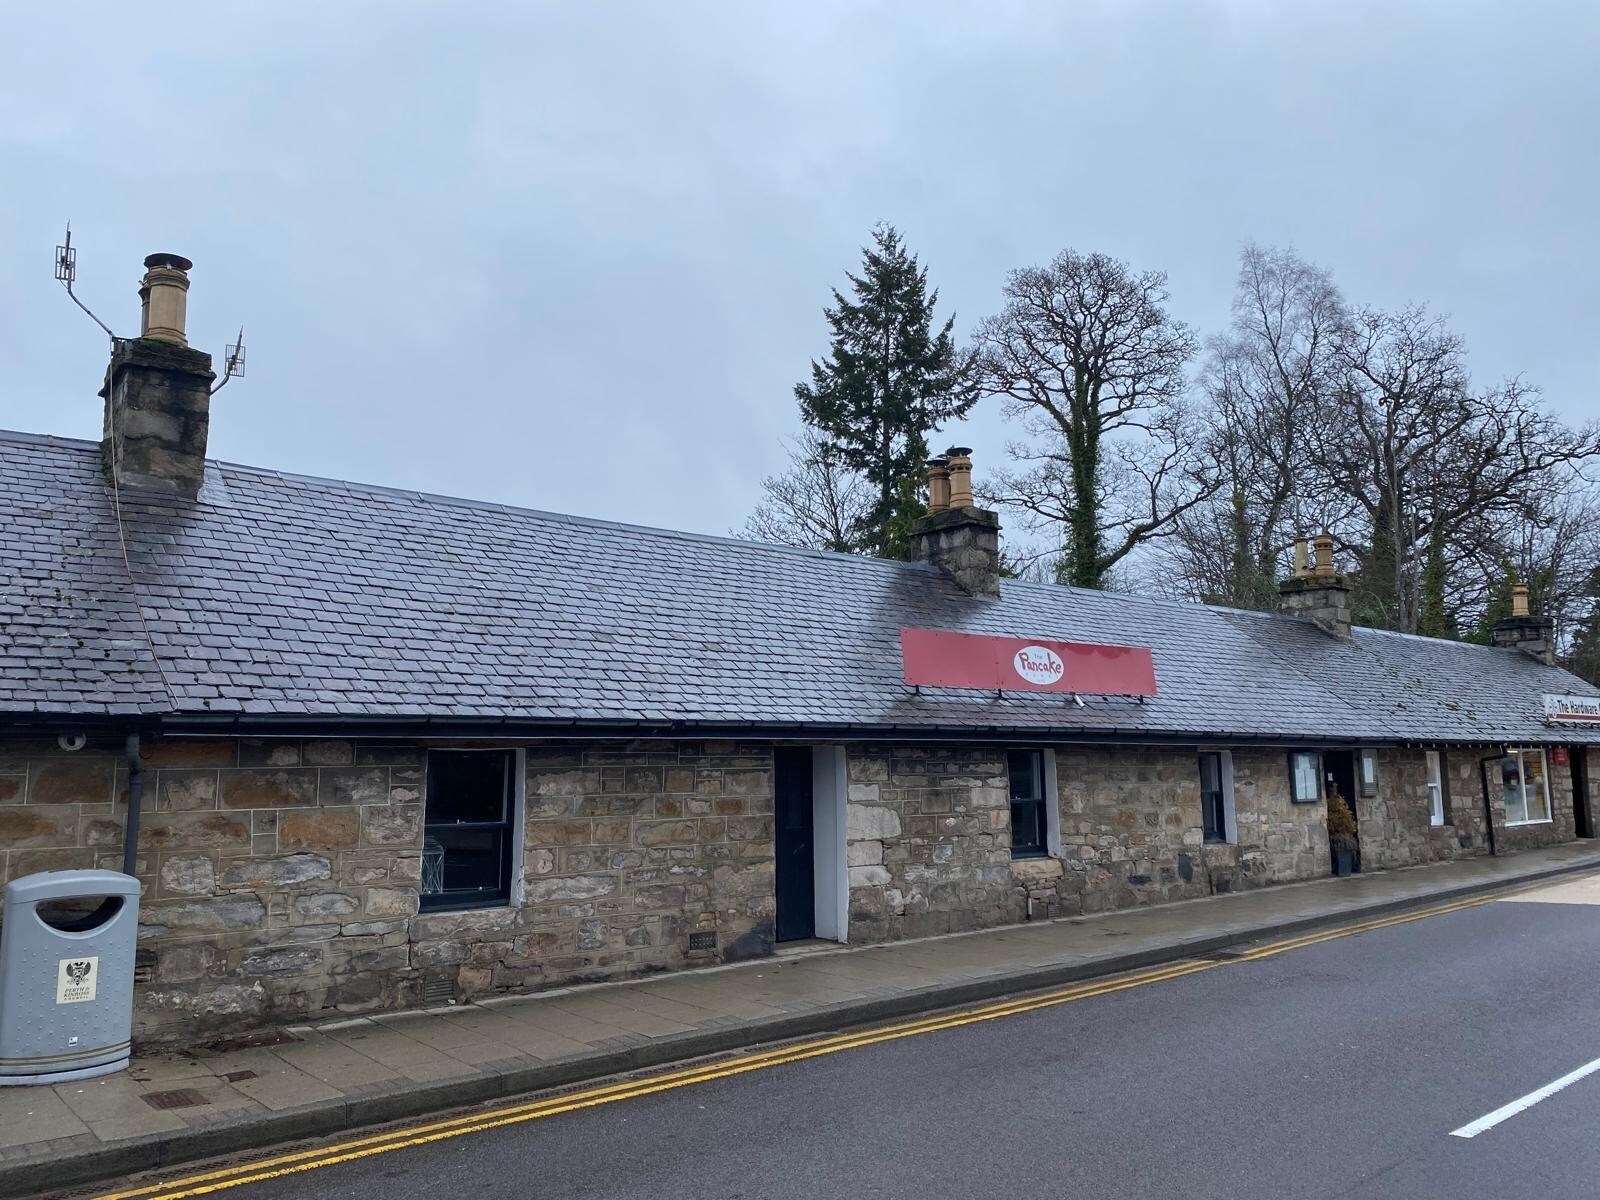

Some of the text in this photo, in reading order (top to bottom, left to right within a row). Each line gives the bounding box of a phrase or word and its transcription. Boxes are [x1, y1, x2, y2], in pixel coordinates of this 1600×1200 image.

[1018, 652, 1062, 674] Pancake
[1557, 699, 1570, 714] The
[1569, 700, 1598, 715] Hardware
